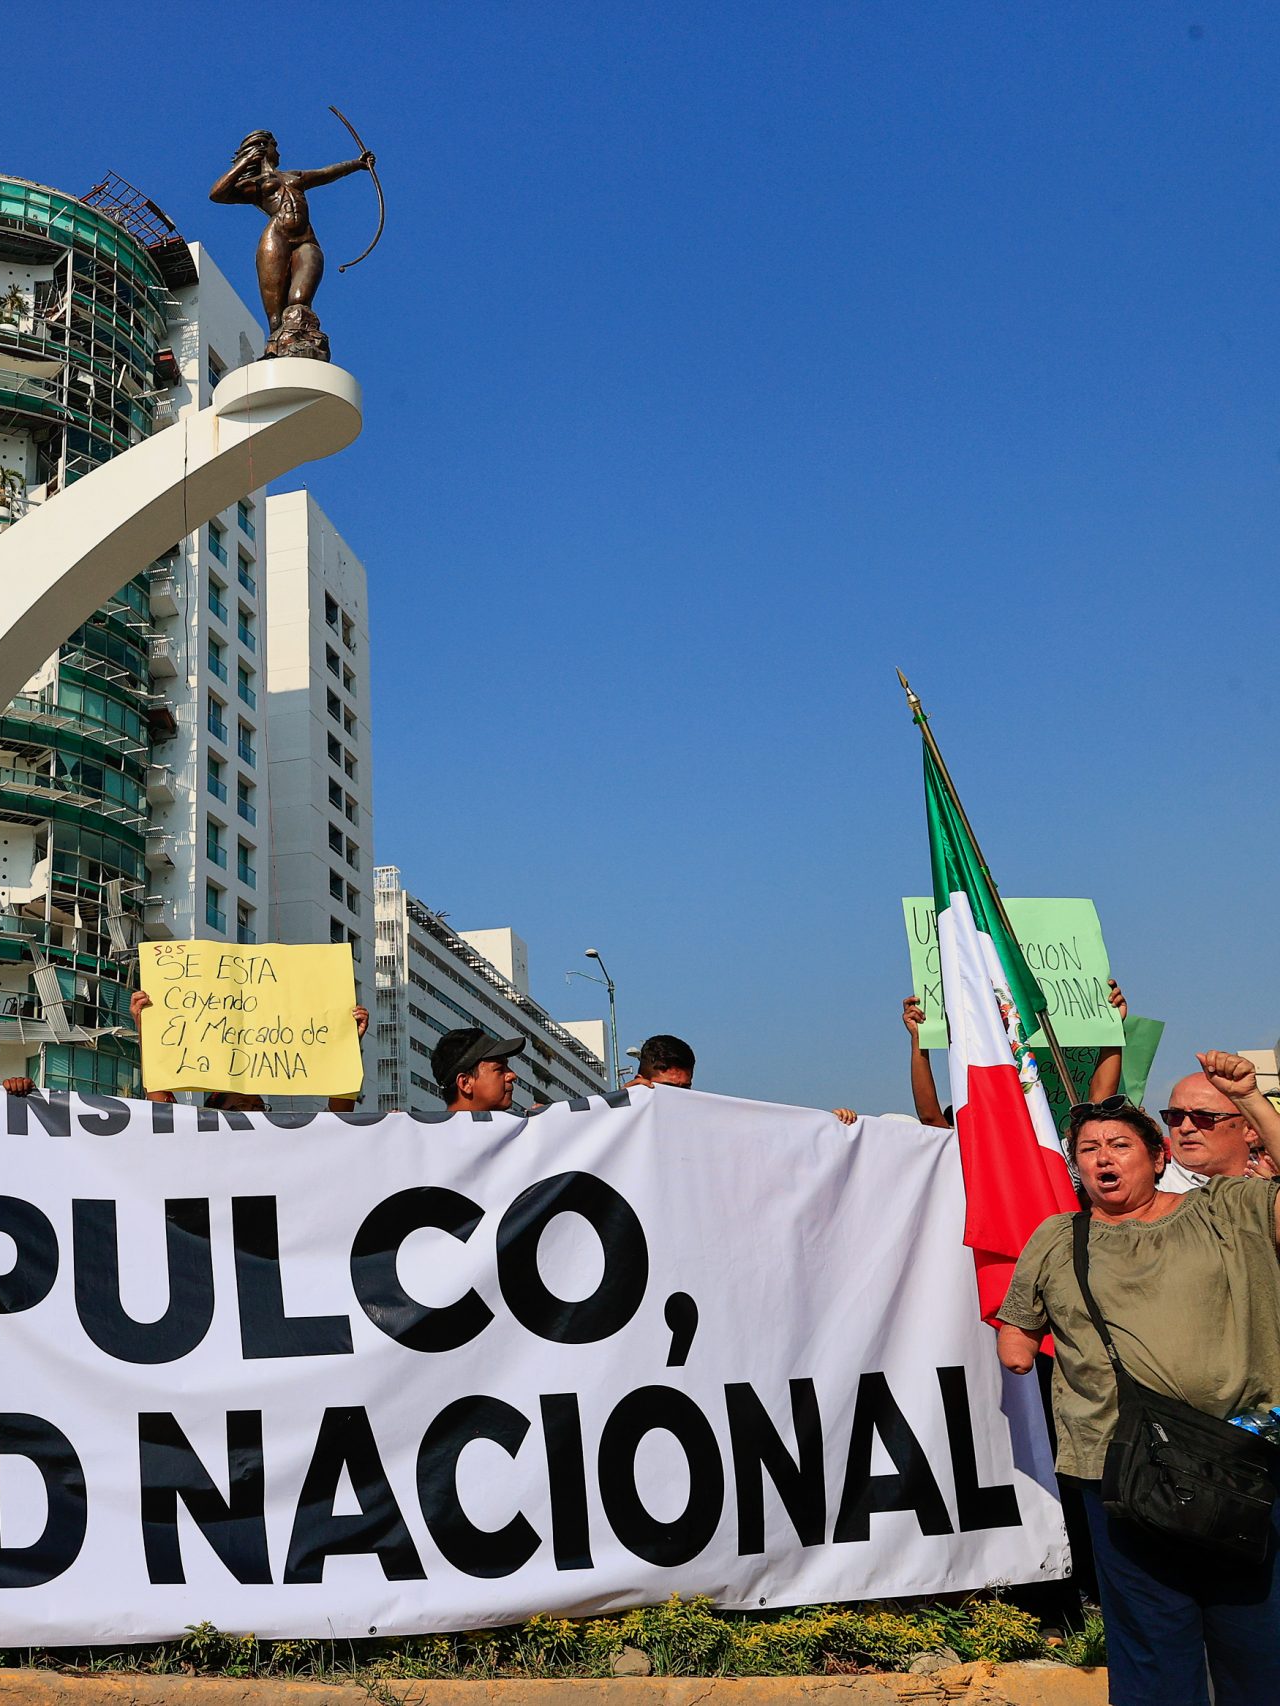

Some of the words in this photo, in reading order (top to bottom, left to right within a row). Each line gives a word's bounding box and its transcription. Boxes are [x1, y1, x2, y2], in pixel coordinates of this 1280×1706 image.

[154, 944, 187, 957] SOS
[156, 953, 202, 981] SE
[216, 954, 278, 985] ESTA
[164, 986, 258, 1023] Cayendo
[1037, 977, 1115, 1022] DIANA
[161, 1015, 186, 1046] El
[200, 1015, 294, 1045] Mercado
[301, 1017, 329, 1045] de
[176, 1048, 210, 1074] La
[227, 1048, 308, 1080] DIANA
[138, 1366, 1022, 1584] NACIONAL
